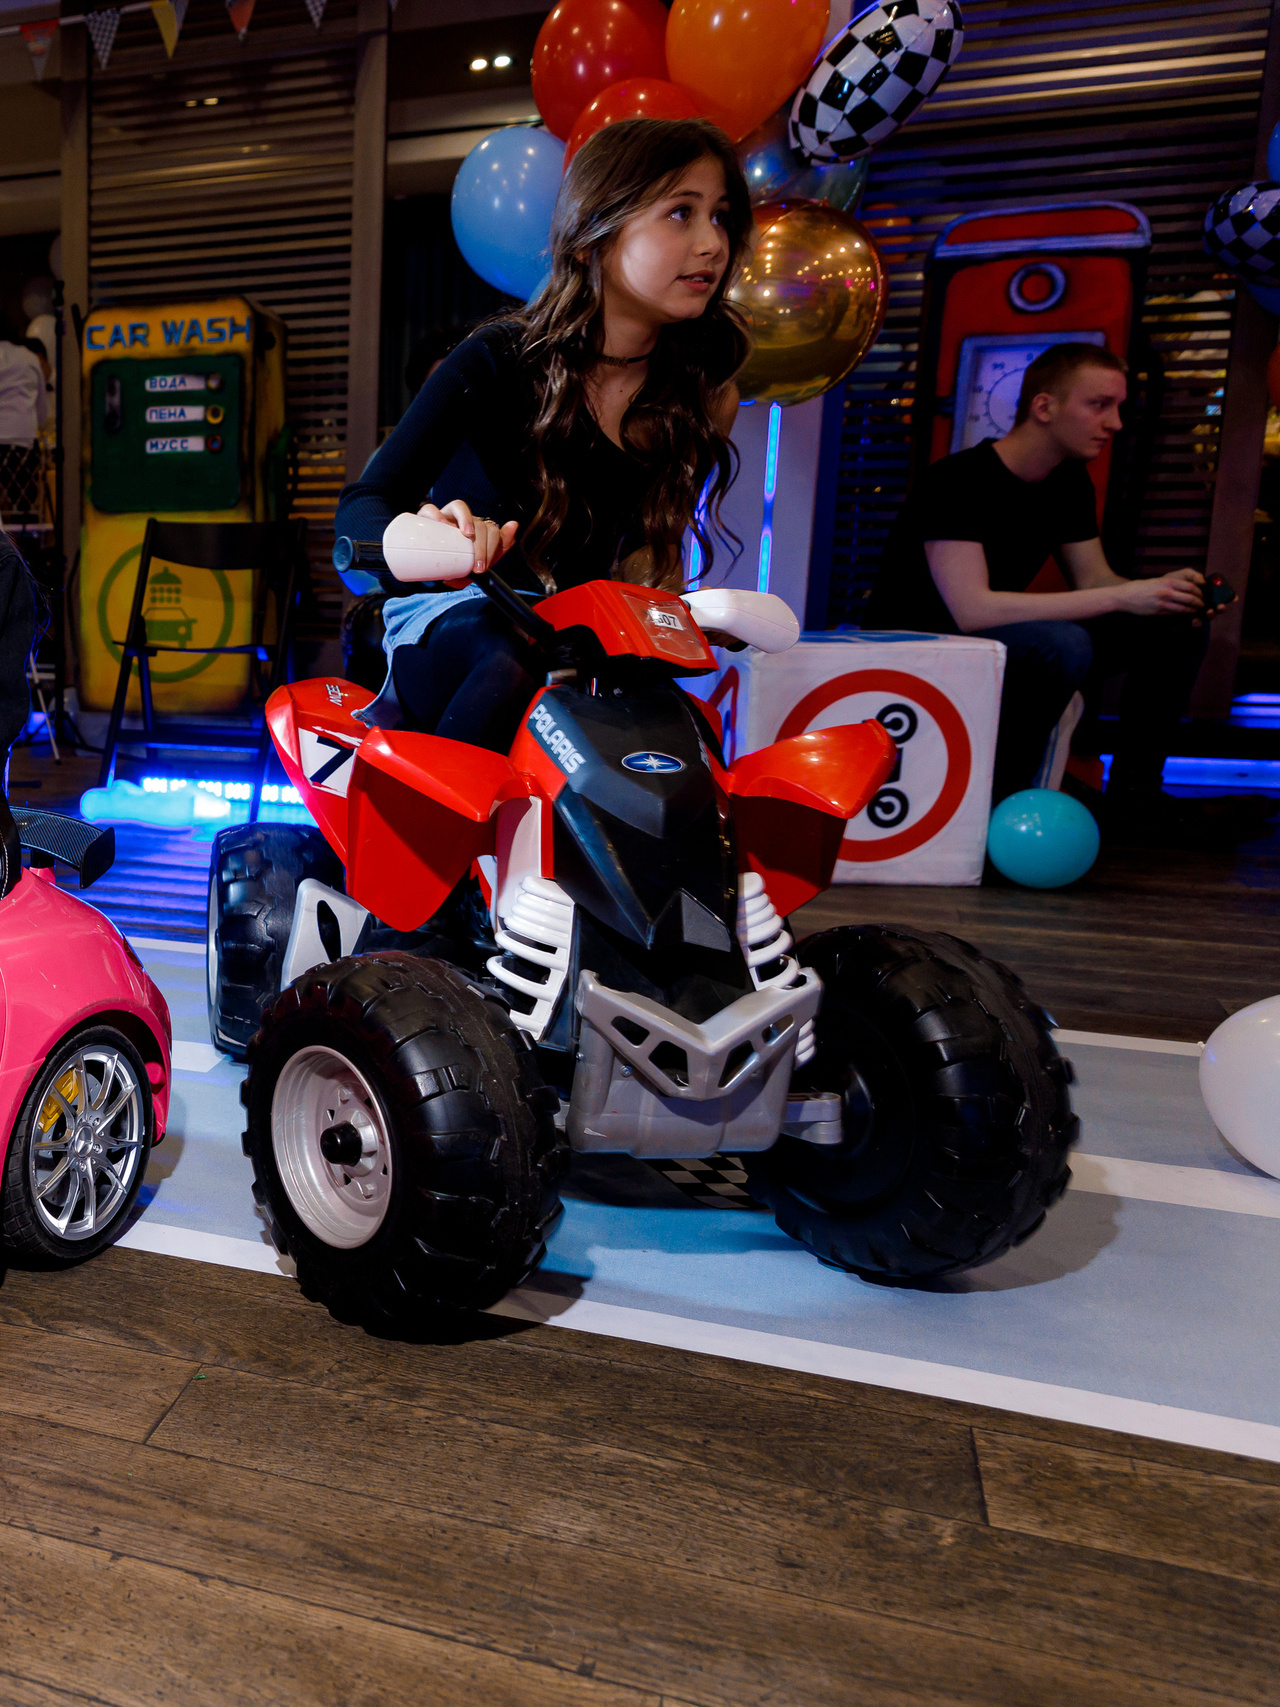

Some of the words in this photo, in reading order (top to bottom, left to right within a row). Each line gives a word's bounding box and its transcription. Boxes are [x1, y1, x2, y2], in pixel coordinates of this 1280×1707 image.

[86, 322, 148, 350] CAR
[161, 316, 251, 346] WASH
[149, 376, 188, 389] ВОДА
[149, 407, 188, 419] ПЕНА
[149, 439, 189, 451] МУСС
[529, 703, 587, 774] POLARIS
[308, 735, 356, 784] 7
